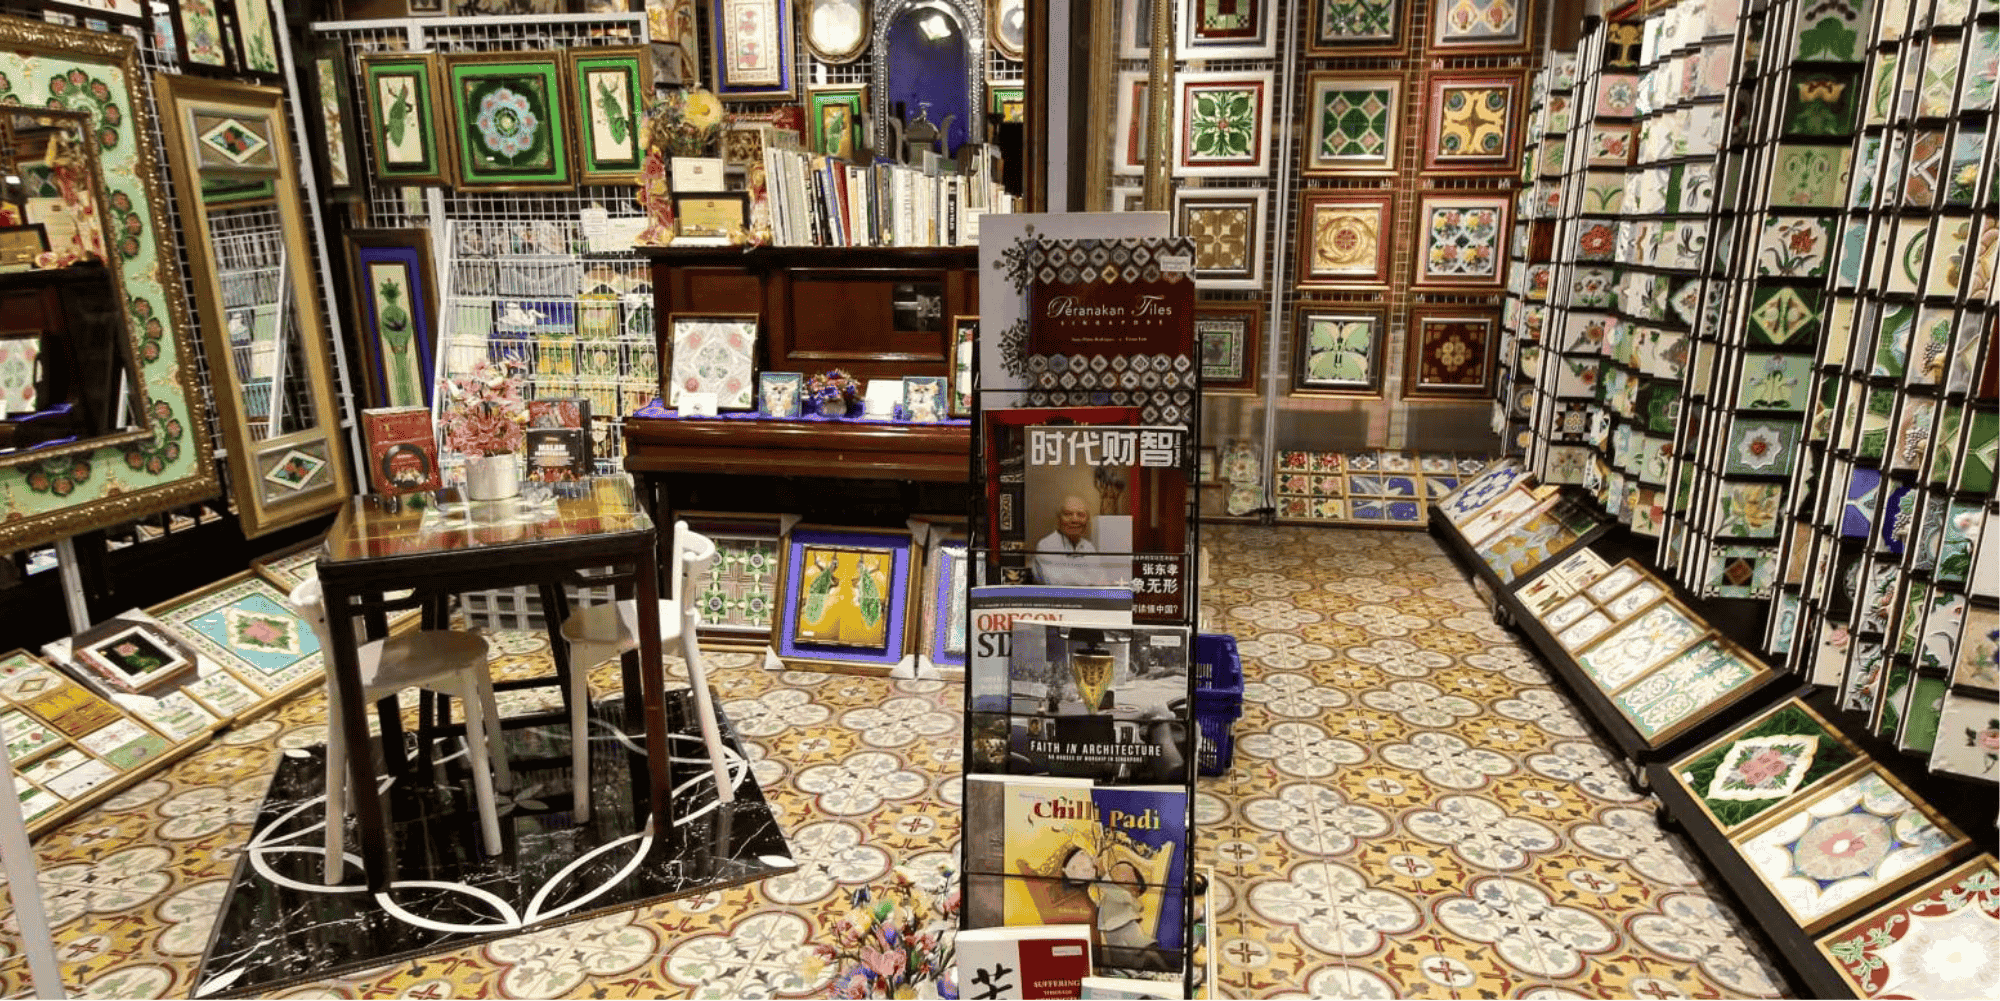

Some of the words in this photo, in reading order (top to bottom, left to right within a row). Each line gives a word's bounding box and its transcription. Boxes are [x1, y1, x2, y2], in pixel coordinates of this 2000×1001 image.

[1047, 296, 1125, 318] Peranakan
[1131, 294, 1172, 316] Tiles
[1031, 431, 1173, 467] 时代财智
[1030, 740, 1060, 753] FAITH
[1066, 743, 1078, 754] IN
[1082, 744, 1161, 756] ARCHITECTURE
[1034, 798, 1101, 822] Chilli
[1109, 808, 1160, 830] Padi
[1033, 980, 1081, 988] SUFFERING
